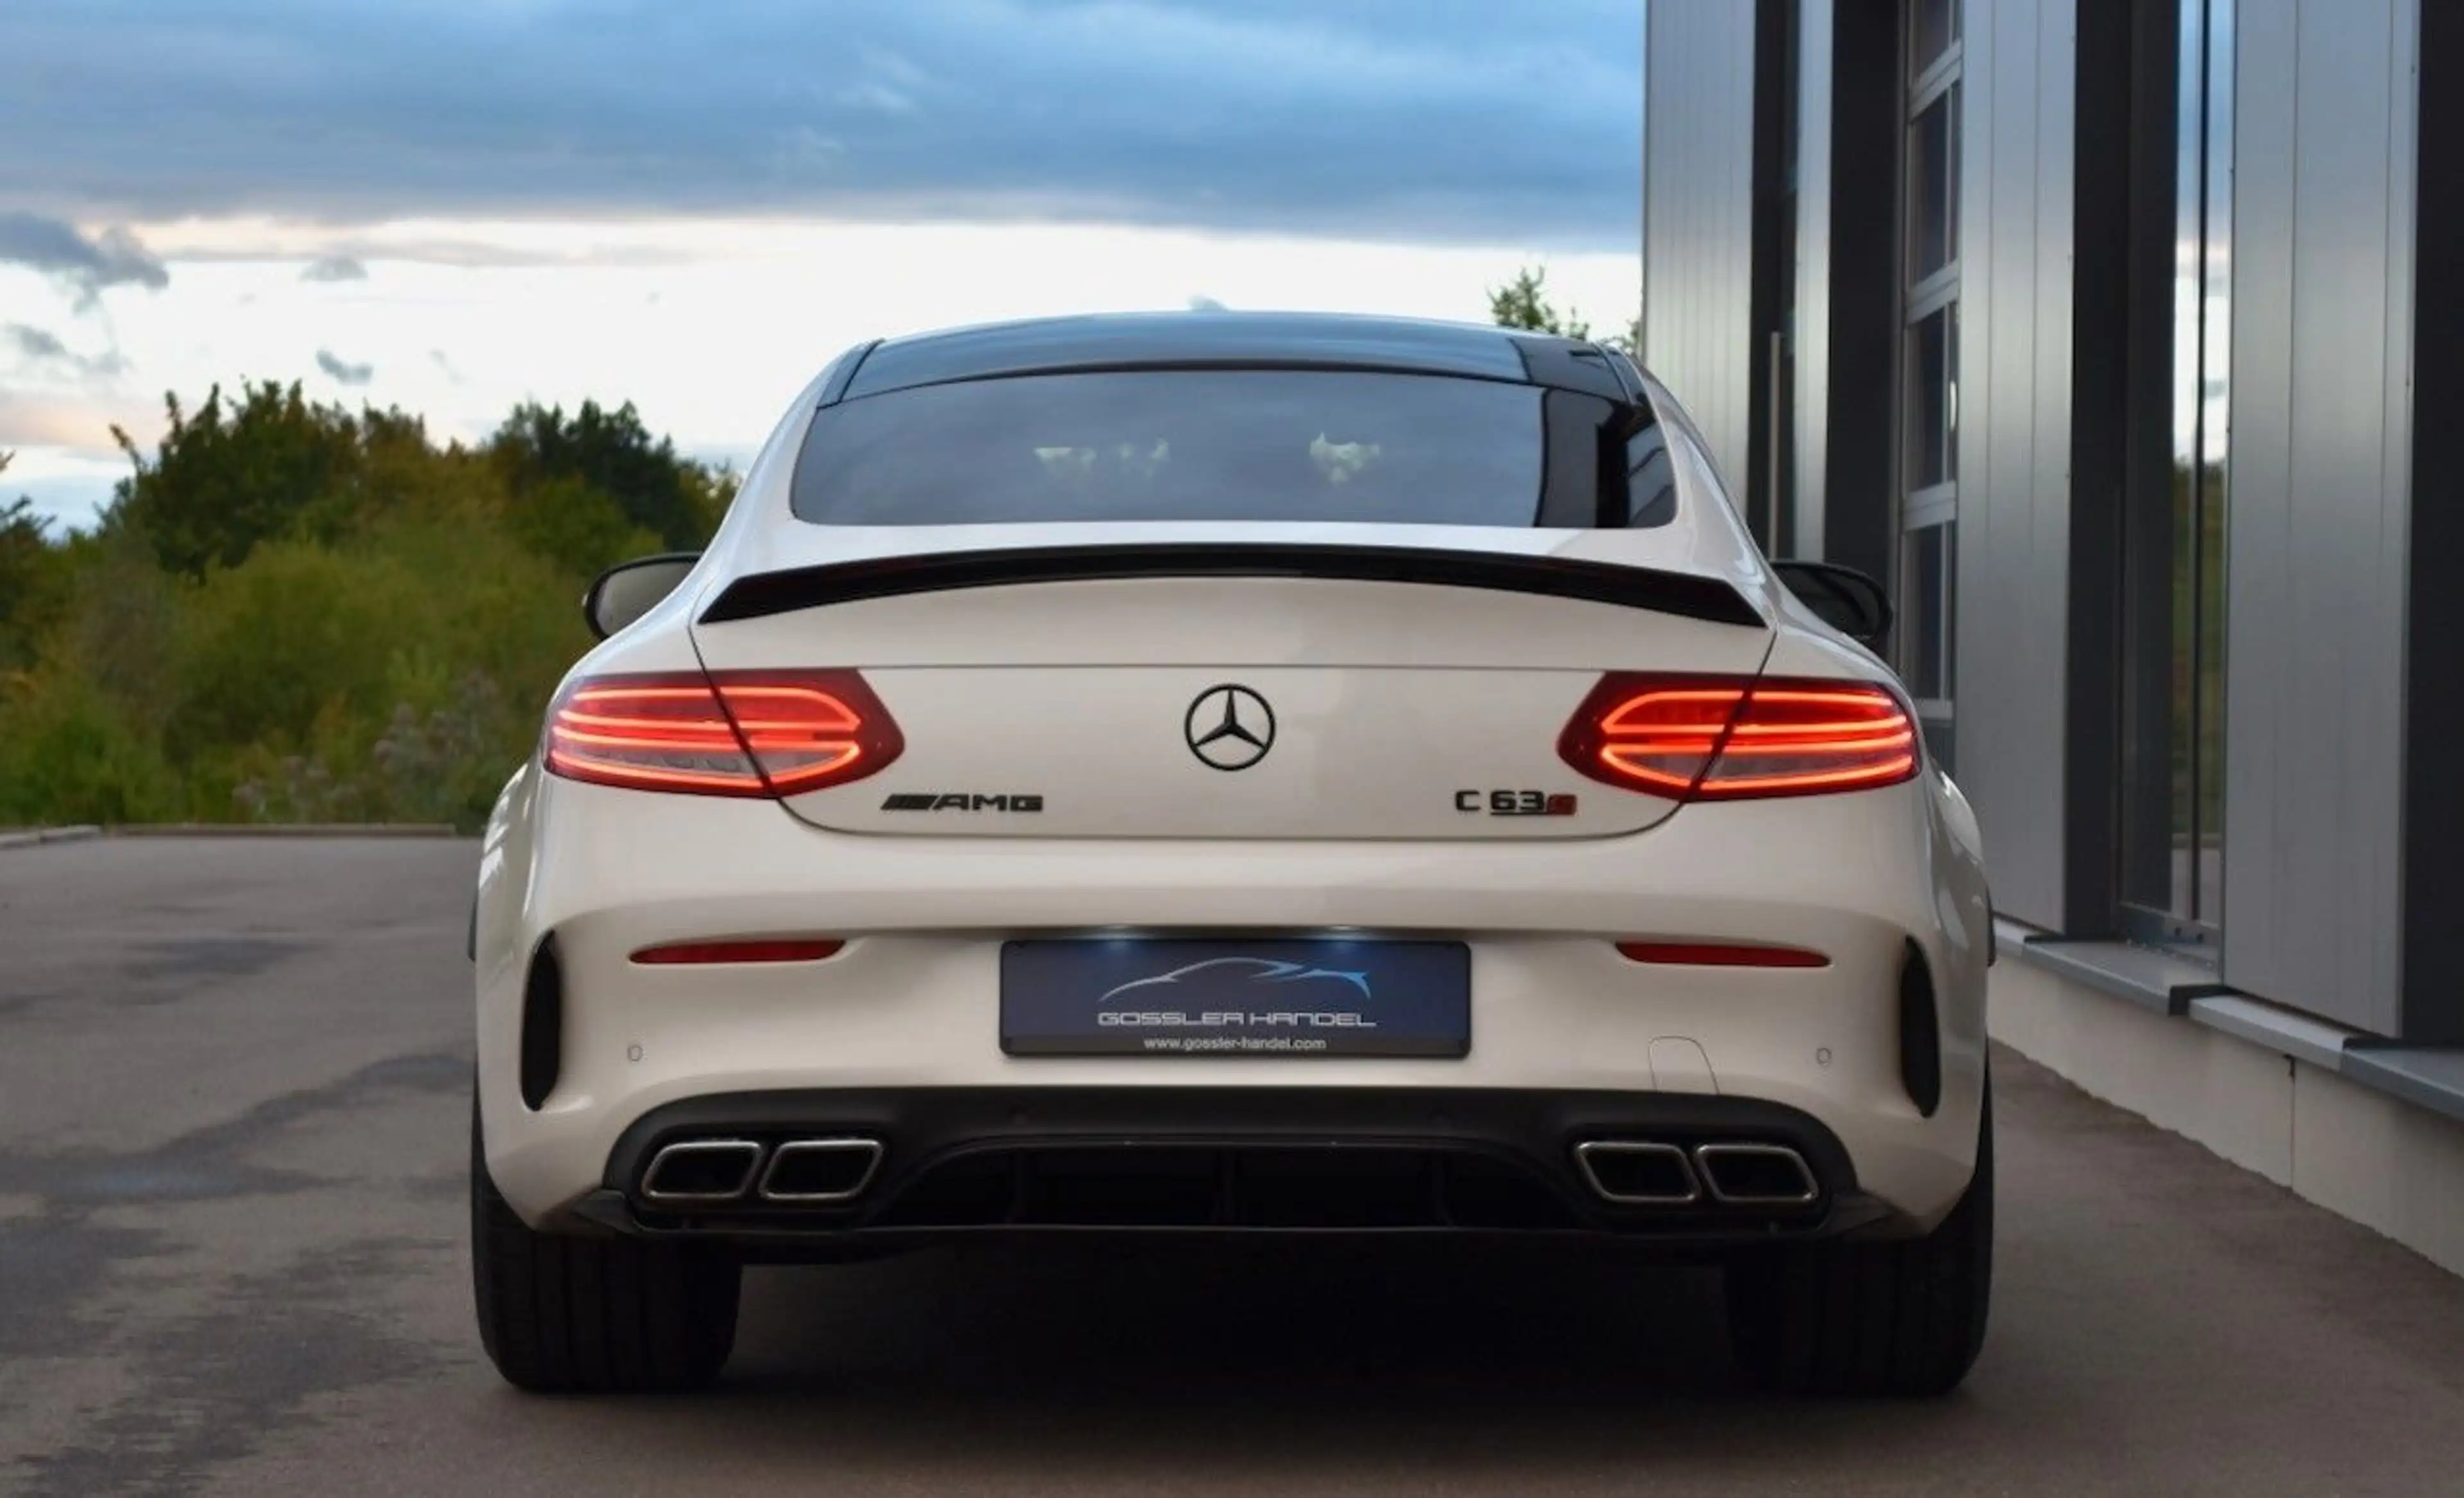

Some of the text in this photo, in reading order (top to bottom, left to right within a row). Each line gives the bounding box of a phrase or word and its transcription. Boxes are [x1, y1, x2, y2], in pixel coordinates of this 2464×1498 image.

[932, 794, 1044, 812] AMG
[1455, 789, 1481, 811] C
[1098, 1012, 1377, 1027] GOSSLER HANDEL
[1143, 1036, 1327, 1051] www.gossler-handel.com
